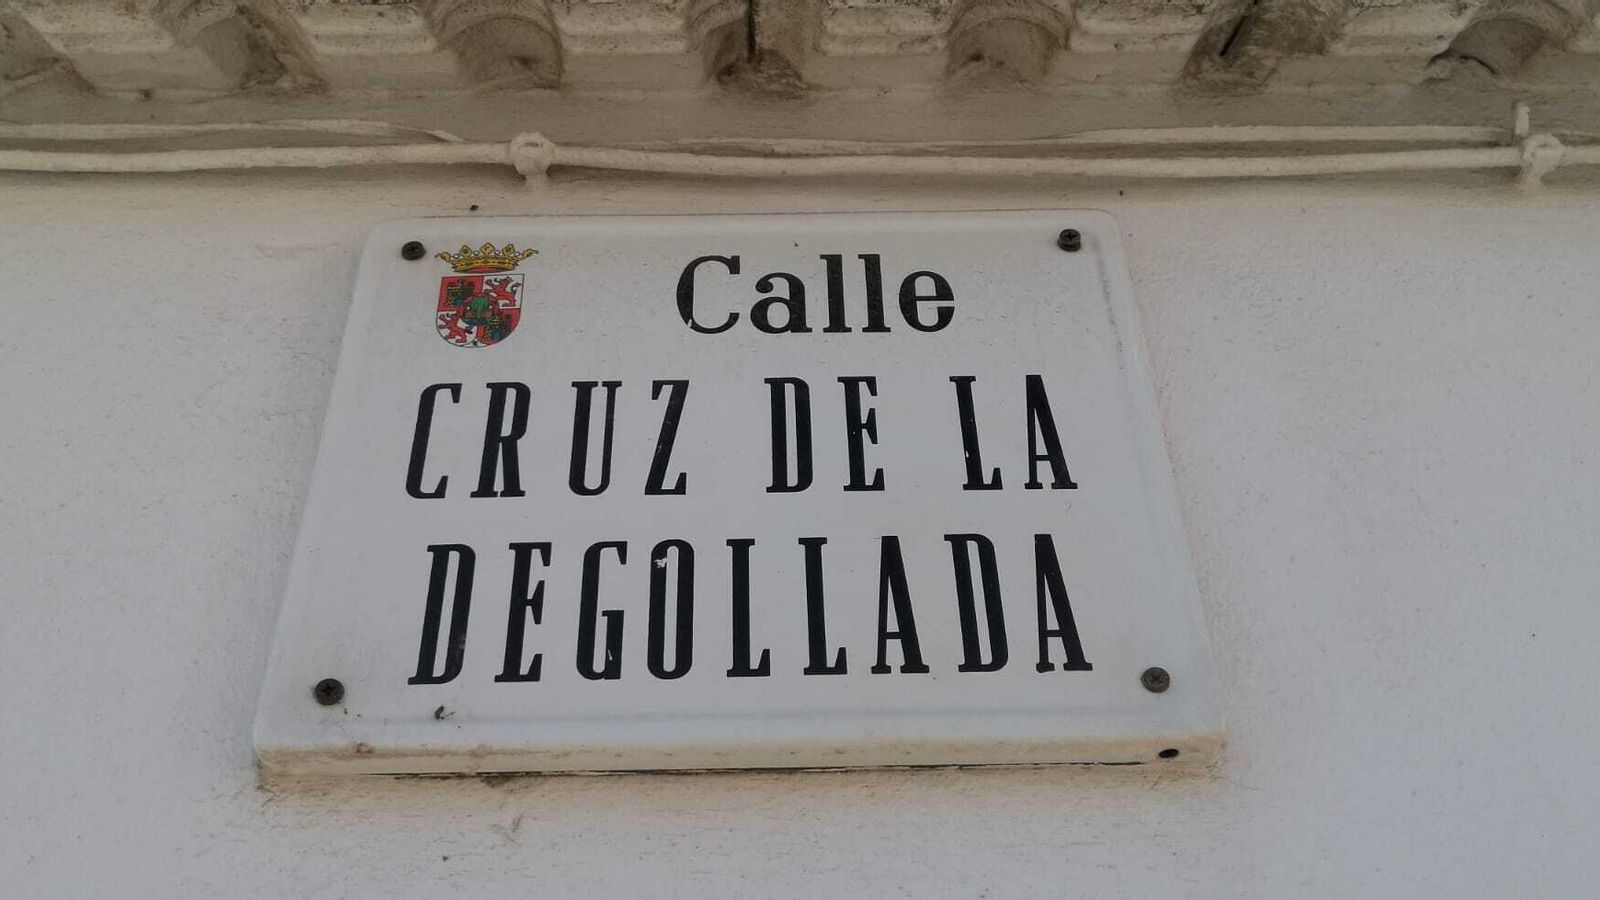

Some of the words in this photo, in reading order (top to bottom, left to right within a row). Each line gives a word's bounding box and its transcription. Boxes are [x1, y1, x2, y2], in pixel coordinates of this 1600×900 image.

[676, 253, 955, 334] Calle
[405, 380, 690, 499] CRUZ
[764, 376, 885, 493] DE
[949, 374, 1078, 490] LA
[407, 533, 1093, 685] DEGOLLADA
